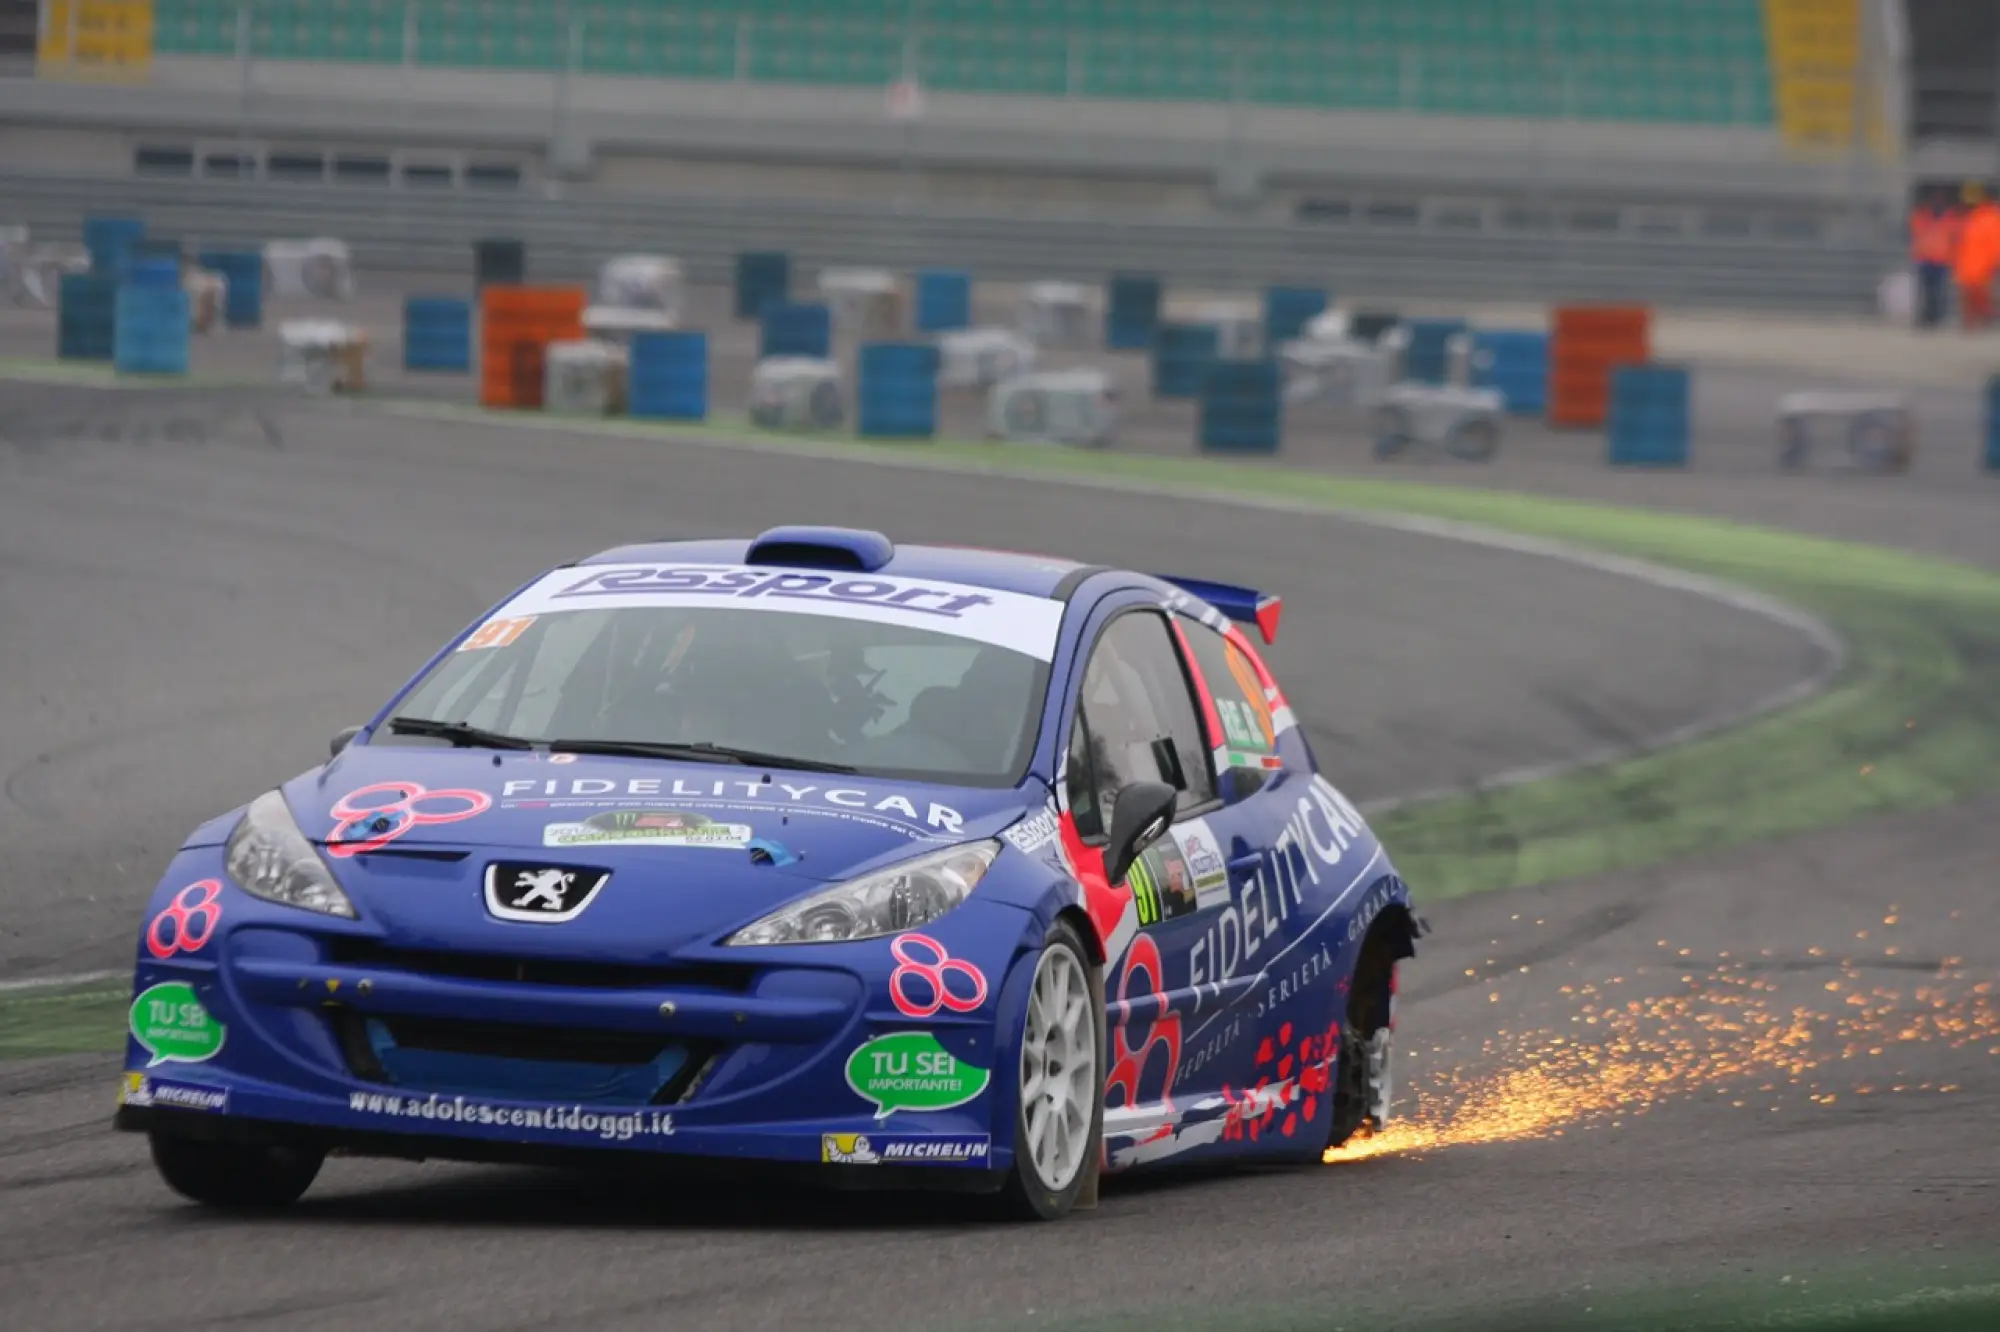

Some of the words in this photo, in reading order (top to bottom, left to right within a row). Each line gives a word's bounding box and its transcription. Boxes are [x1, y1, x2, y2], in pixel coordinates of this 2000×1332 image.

[502, 778, 965, 834] FIDELITYCAR
[870, 1052, 908, 1075] TU
[916, 1052, 956, 1076] SEI
[868, 1078, 962, 1092] IMPORTANTE!
[350, 1092, 676, 1139] www.adolescentidoggi.it
[884, 1143, 988, 1157] MICHELIN
